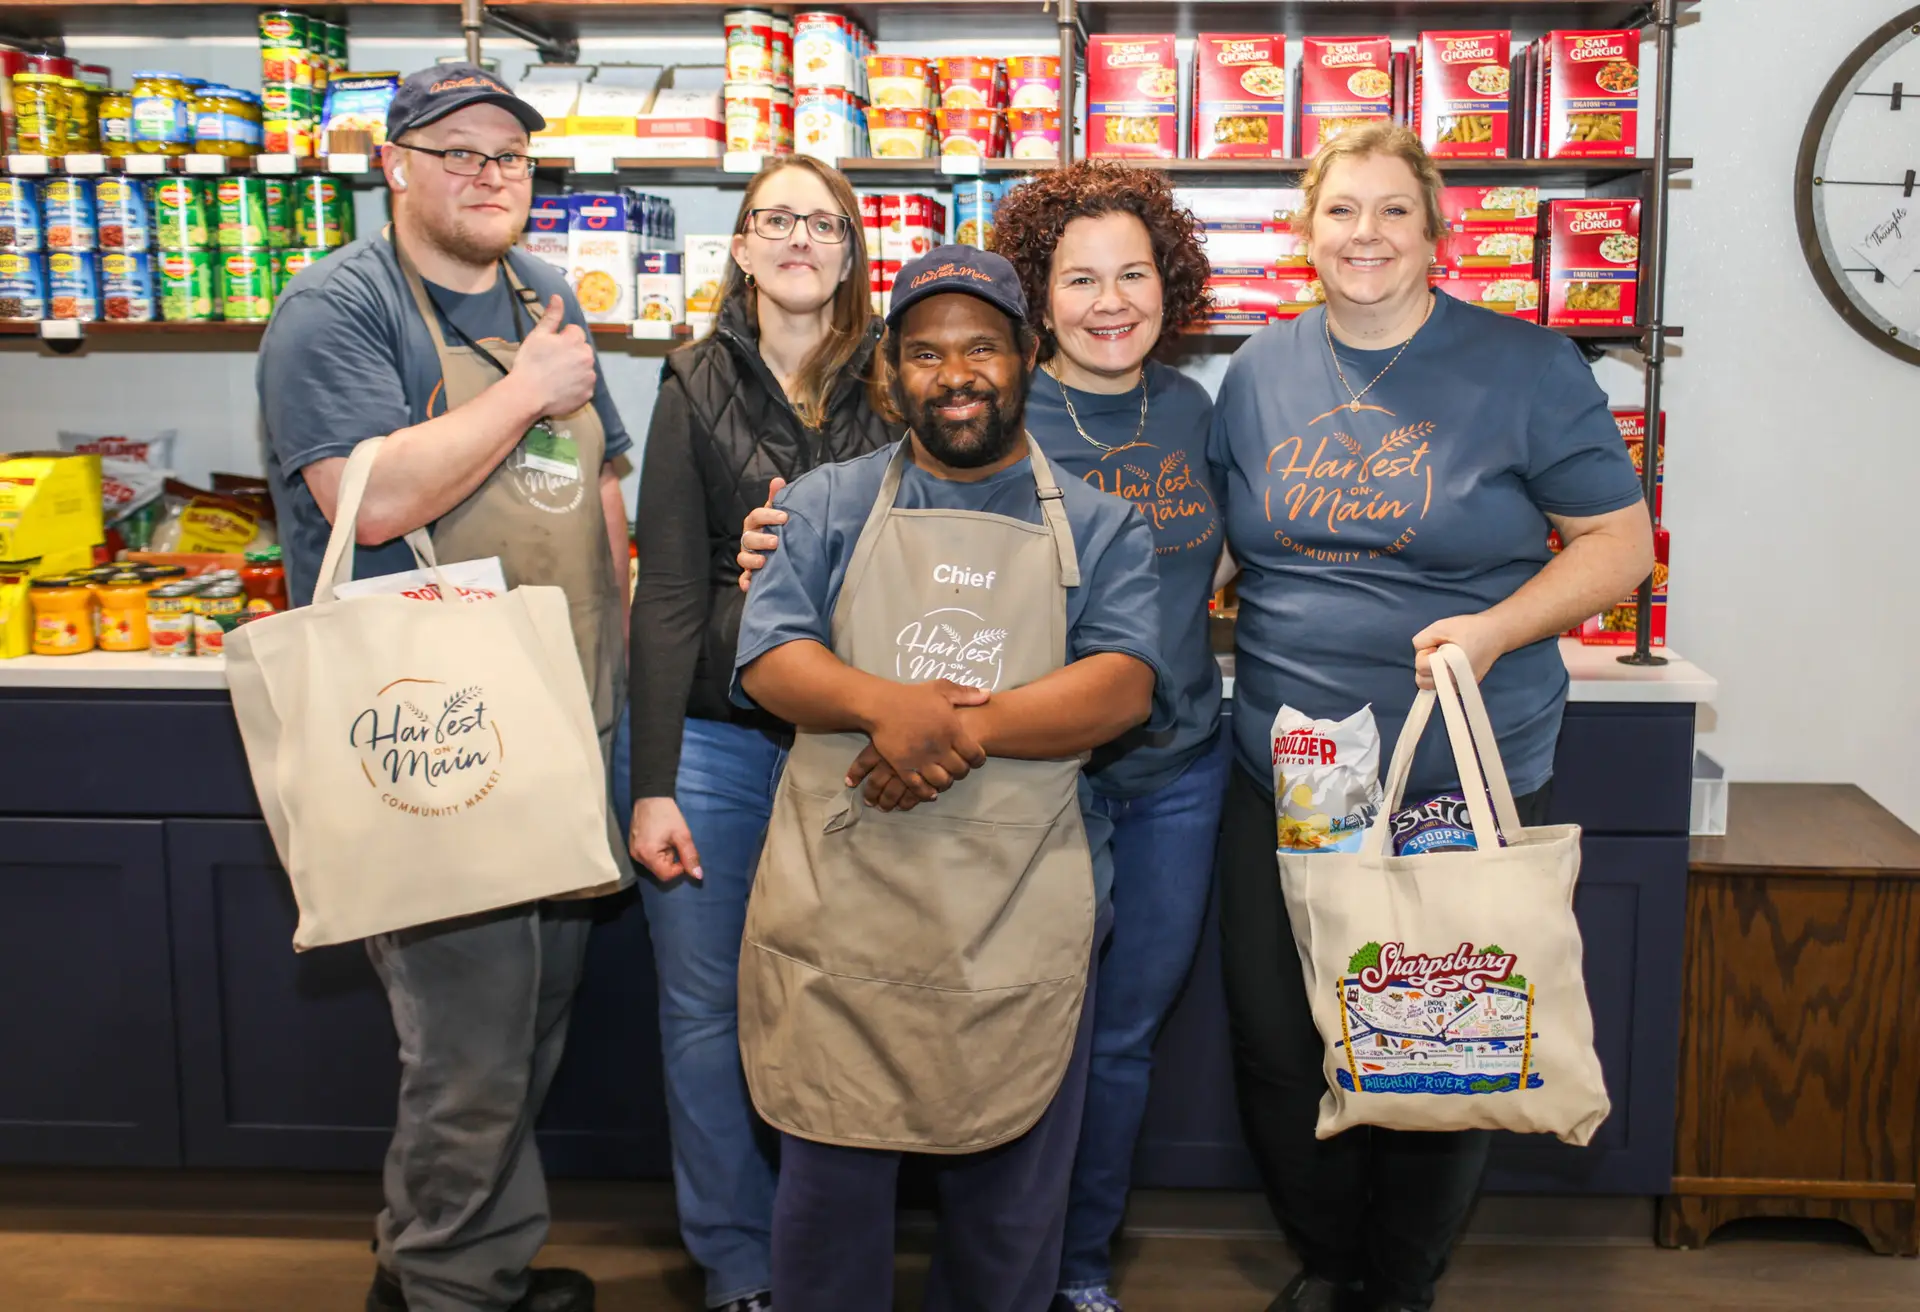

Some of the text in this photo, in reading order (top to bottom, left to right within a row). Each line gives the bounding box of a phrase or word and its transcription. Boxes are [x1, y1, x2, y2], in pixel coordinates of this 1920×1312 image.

[1121, 45, 1145, 53] SAN
[1231, 43, 1255, 53] SAN
[1335, 45, 1358, 54] SAN
[1455, 41, 1478, 50] SAN
[1585, 39, 1608, 49] SAN
[1107, 52, 1159, 65] GIORGIO
[1217, 50, 1269, 64] GIORGIO
[1321, 52, 1372, 65] GIORGIO
[1441, 48, 1494, 62] GIORGIO
[1570, 46, 1623, 60] GIORGIO
[1584, 211, 1607, 220] SAN
[1569, 219, 1622, 232] GIORGIO
[1869, 208, 1907, 247] Thoughts
[1266, 421, 1437, 484] Harvest
[1349, 485, 1370, 496] ON
[1284, 483, 1414, 534] Main
[1273, 529, 1361, 564] COMMUNITY
[933, 563, 997, 590] Chief
[896, 621, 1009, 663] Harvest
[909, 655, 989, 689] Main
[948, 662, 966, 671] ON
[350, 686, 487, 751] Harvest
[432, 745, 454, 757] ON
[1272, 735, 1338, 766] BOULDER
[382, 747, 491, 788] Main
[381, 769, 502, 818] COMMUNITY MARKET
[1408, 830, 1467, 850] SCOOPS!
[1359, 942, 1517, 997] Sharpsburg
[1428, 1006, 1445, 1014] GYM
[1424, 1076, 1466, 1090] RIVER
